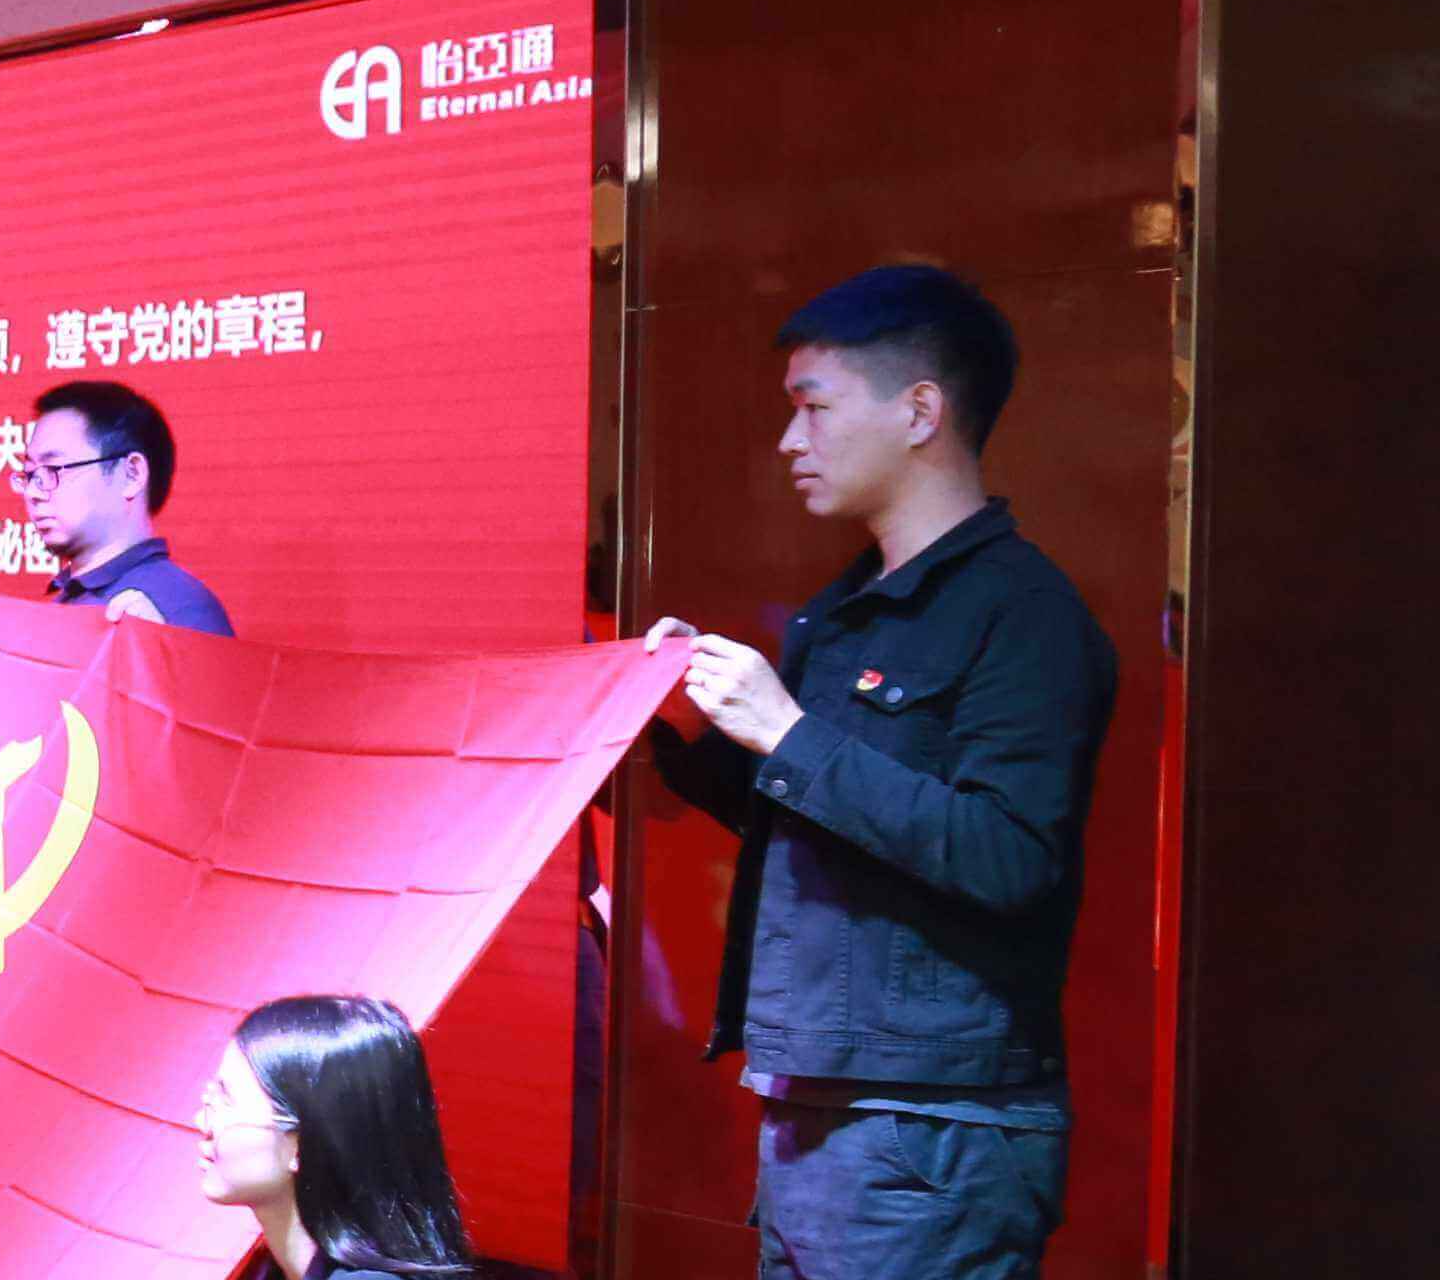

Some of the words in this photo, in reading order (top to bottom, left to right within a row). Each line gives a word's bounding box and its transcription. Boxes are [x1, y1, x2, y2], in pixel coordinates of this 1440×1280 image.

[421, 24, 554, 89] 怡亞通
[420, 83, 525, 121] Eternal
[530, 76, 593, 105] Asia
